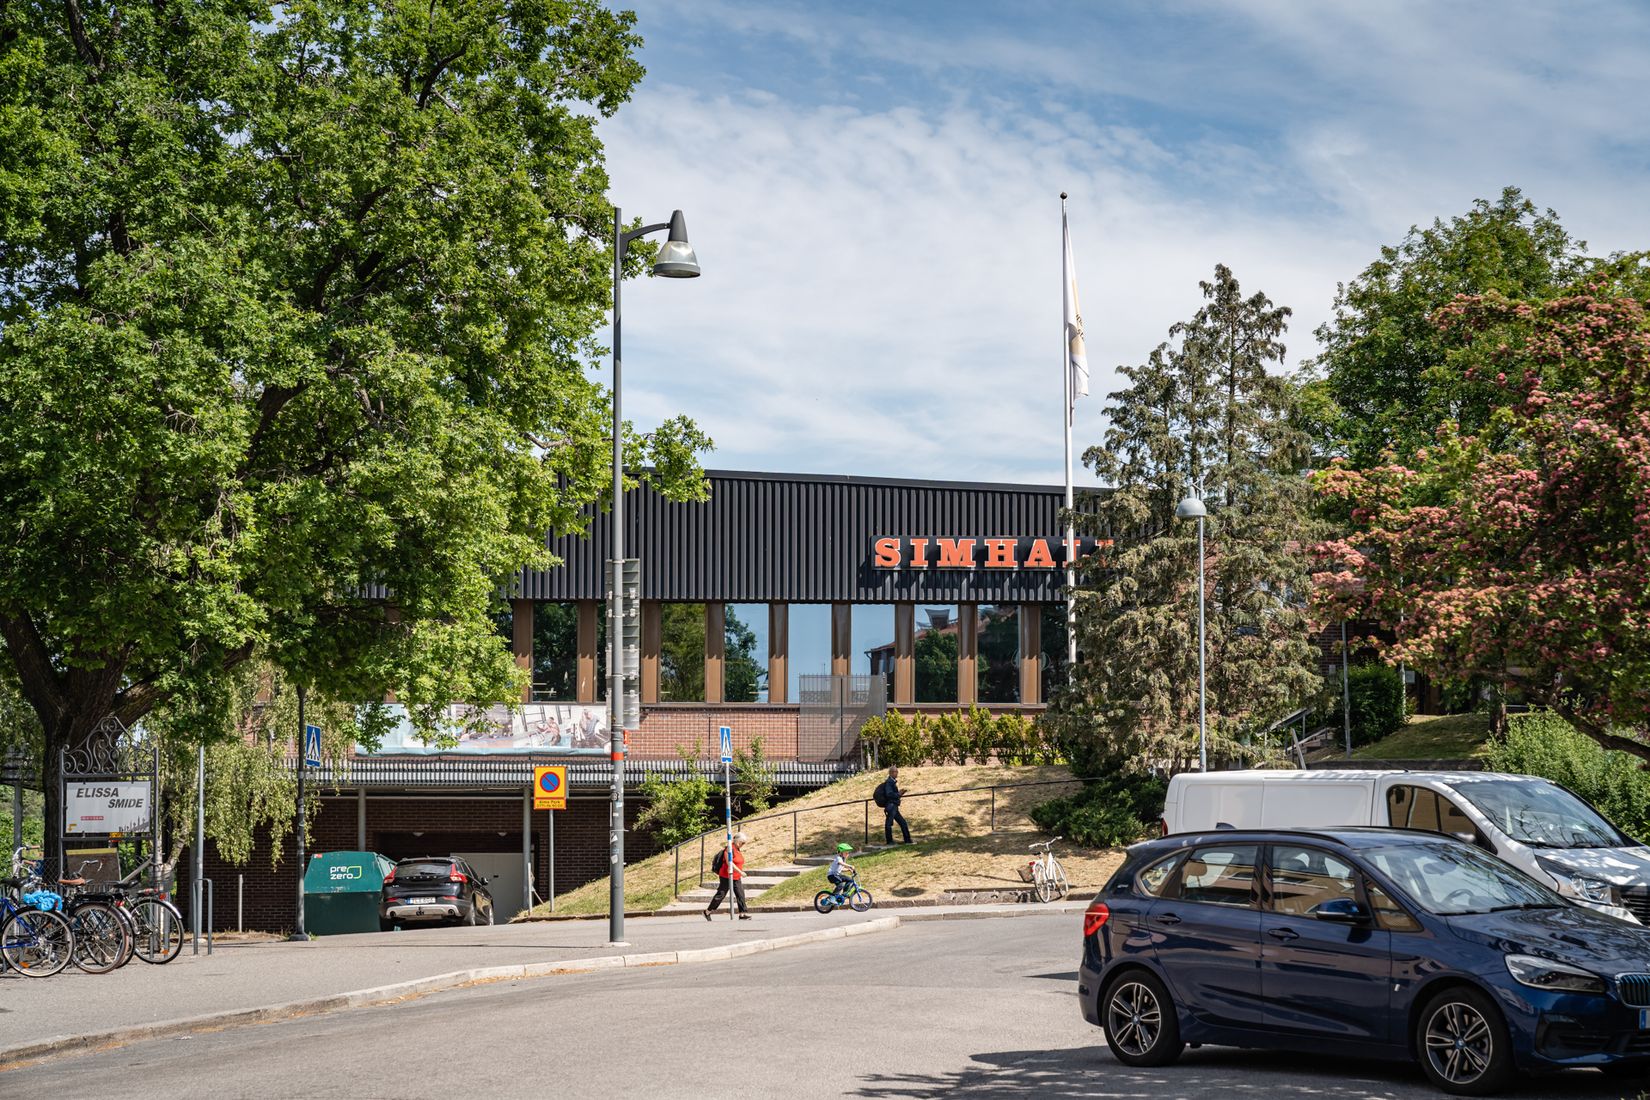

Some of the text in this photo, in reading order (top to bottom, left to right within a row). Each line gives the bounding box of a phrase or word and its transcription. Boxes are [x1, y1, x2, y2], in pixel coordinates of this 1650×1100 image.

[874, 537, 1117, 568] SIMHA
[76, 787, 119, 798] ELISSA
[107, 798, 144, 809] SMIDE
[330, 866, 347, 874] pre
